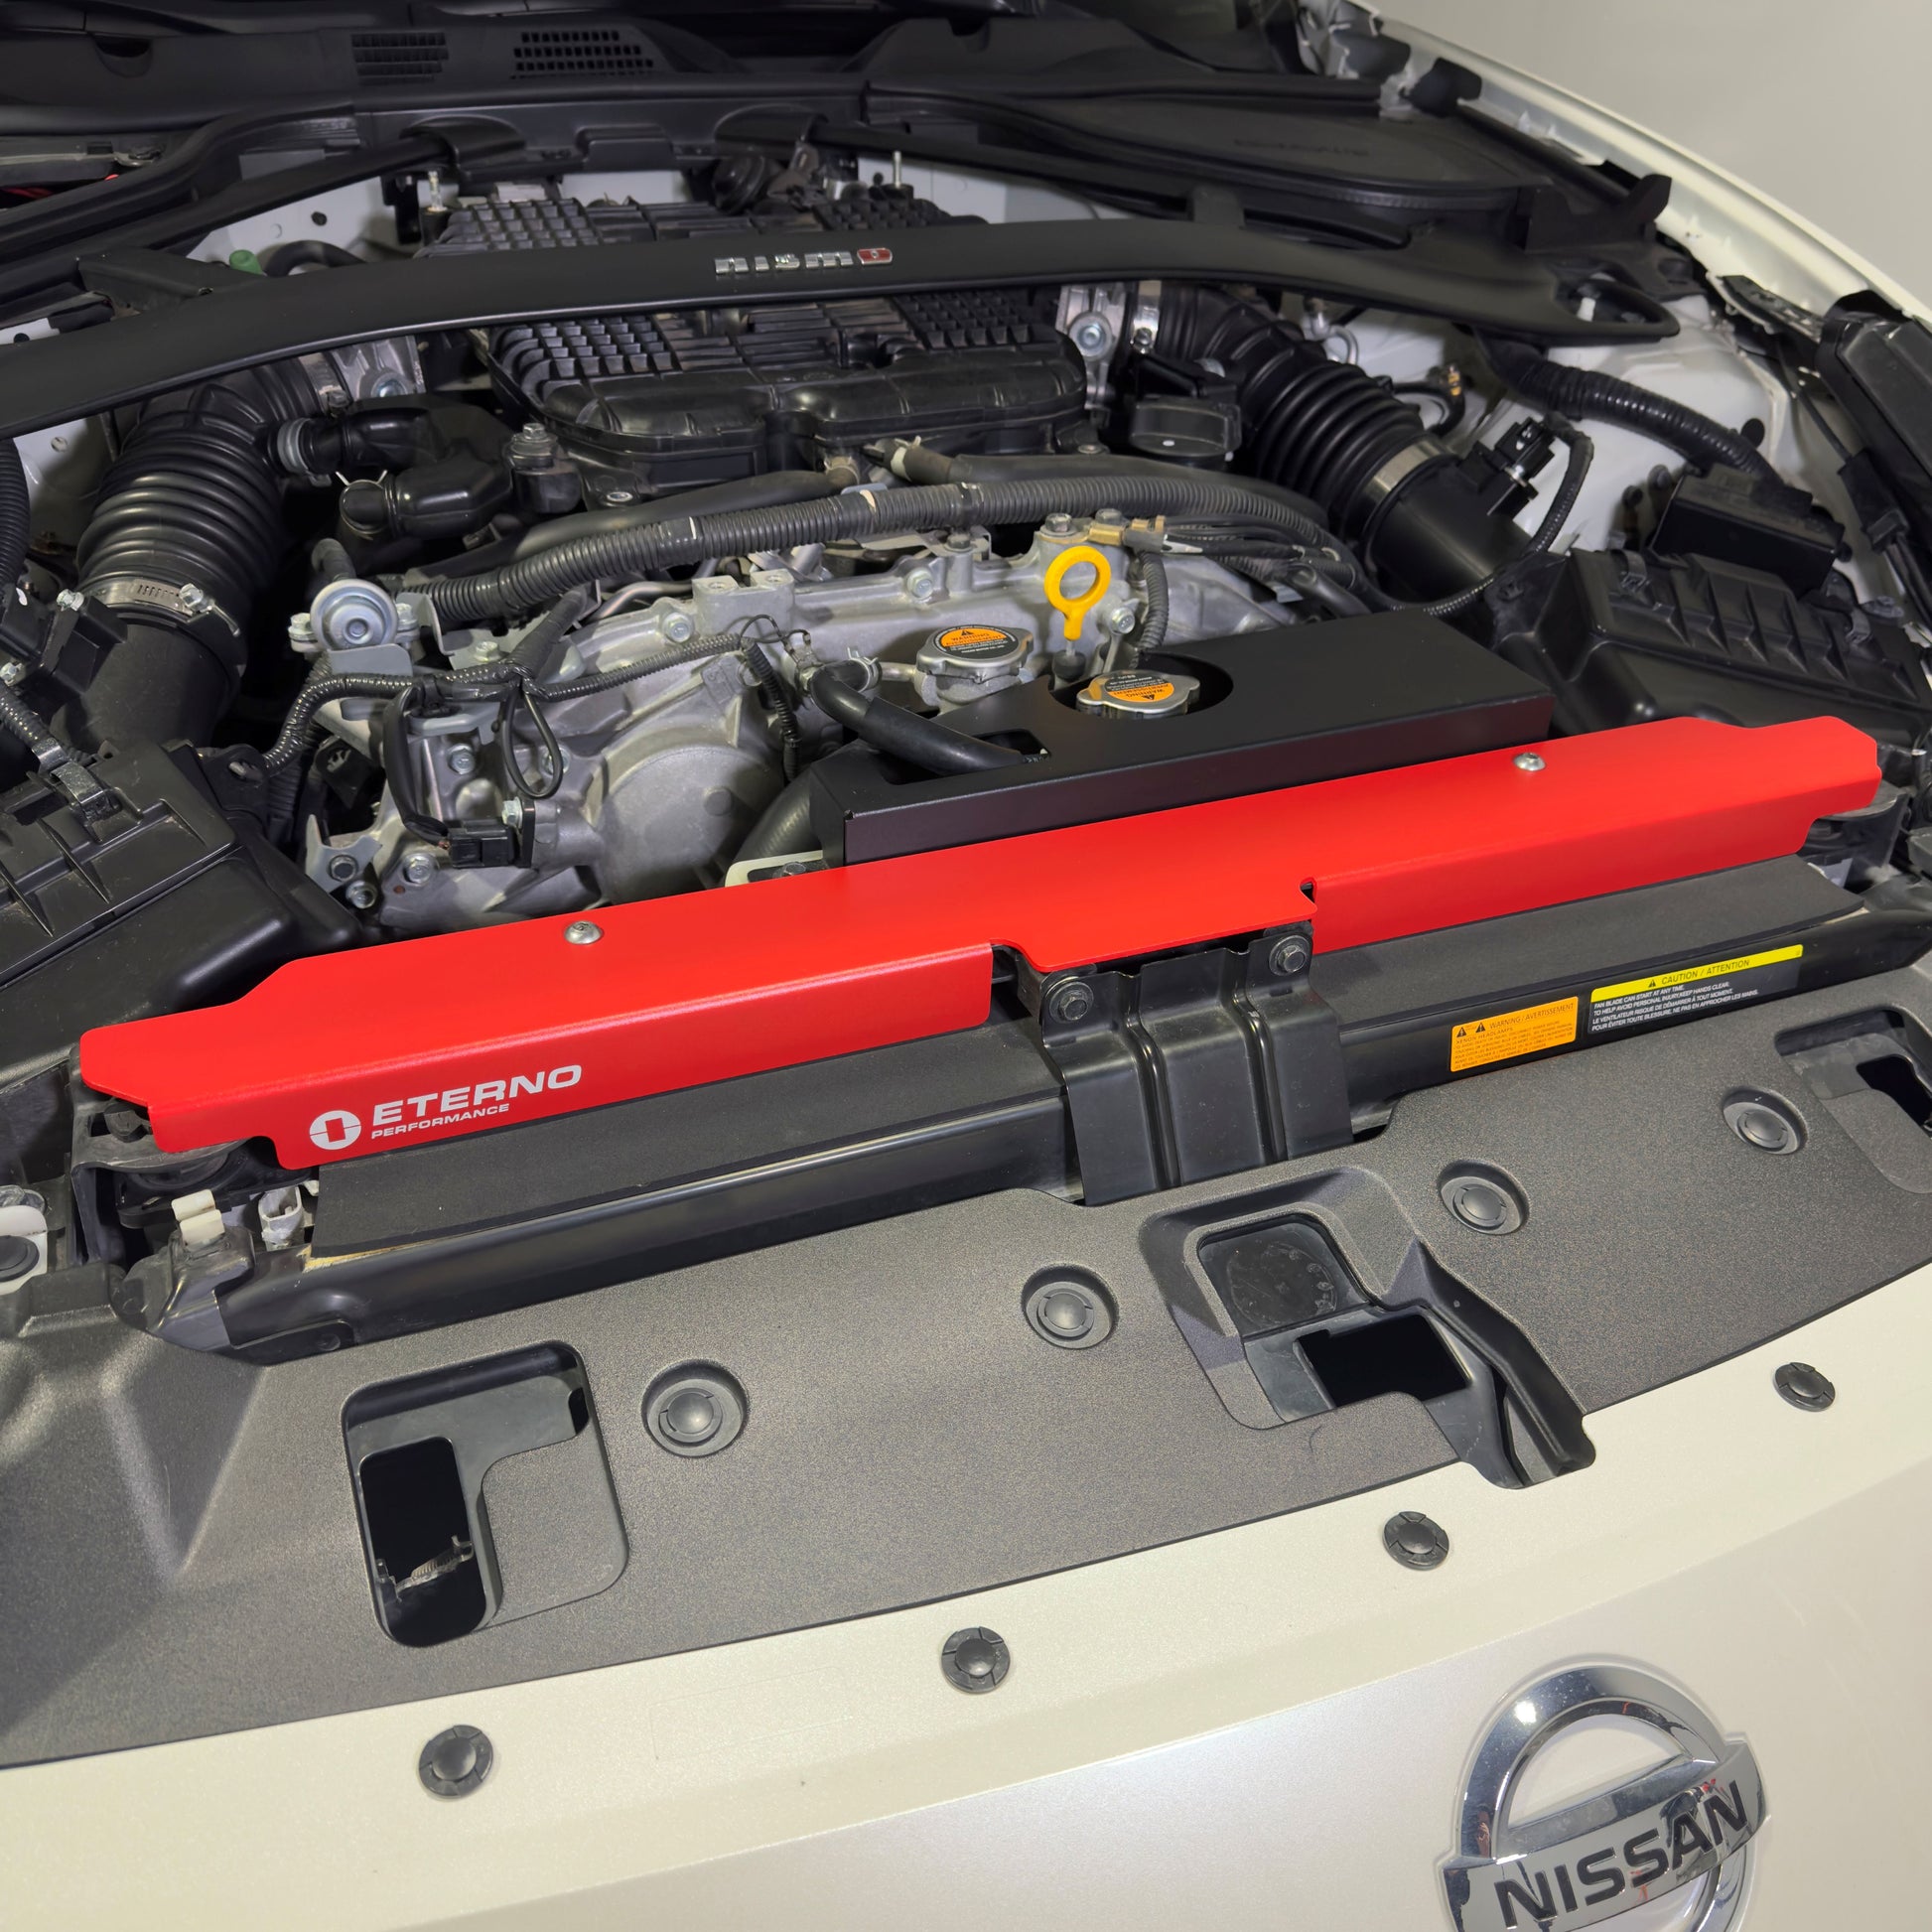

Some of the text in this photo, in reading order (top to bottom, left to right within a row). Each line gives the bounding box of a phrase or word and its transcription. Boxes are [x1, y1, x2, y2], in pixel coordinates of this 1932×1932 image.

[1662, 970, 1698, 985] CAUTION
[1708, 958, 1749, 975] ATTENTION
[1602, 1006, 1615, 1015] HELP
[1616, 1003, 1632, 1012] AVOID
[1633, 996, 1661, 1008] PERSONAL
[1694, 986, 1711, 995] HANDS
[1606, 998, 1622, 1007] BLADE
[1636, 991, 1652, 1001] START
[1490, 1016, 1521, 1030] WARNING
[1525, 1003, 1573, 1021] AVERTISSEMENT
[1592, 1023, 1607, 1032] POUR
[1627, 1015, 1643, 1024] TOUTE
[371, 1064, 582, 1127] ETERNO
[371, 1103, 509, 1140] PERFORMANCE
[1493, 1780, 1748, 1929] NISSAN
